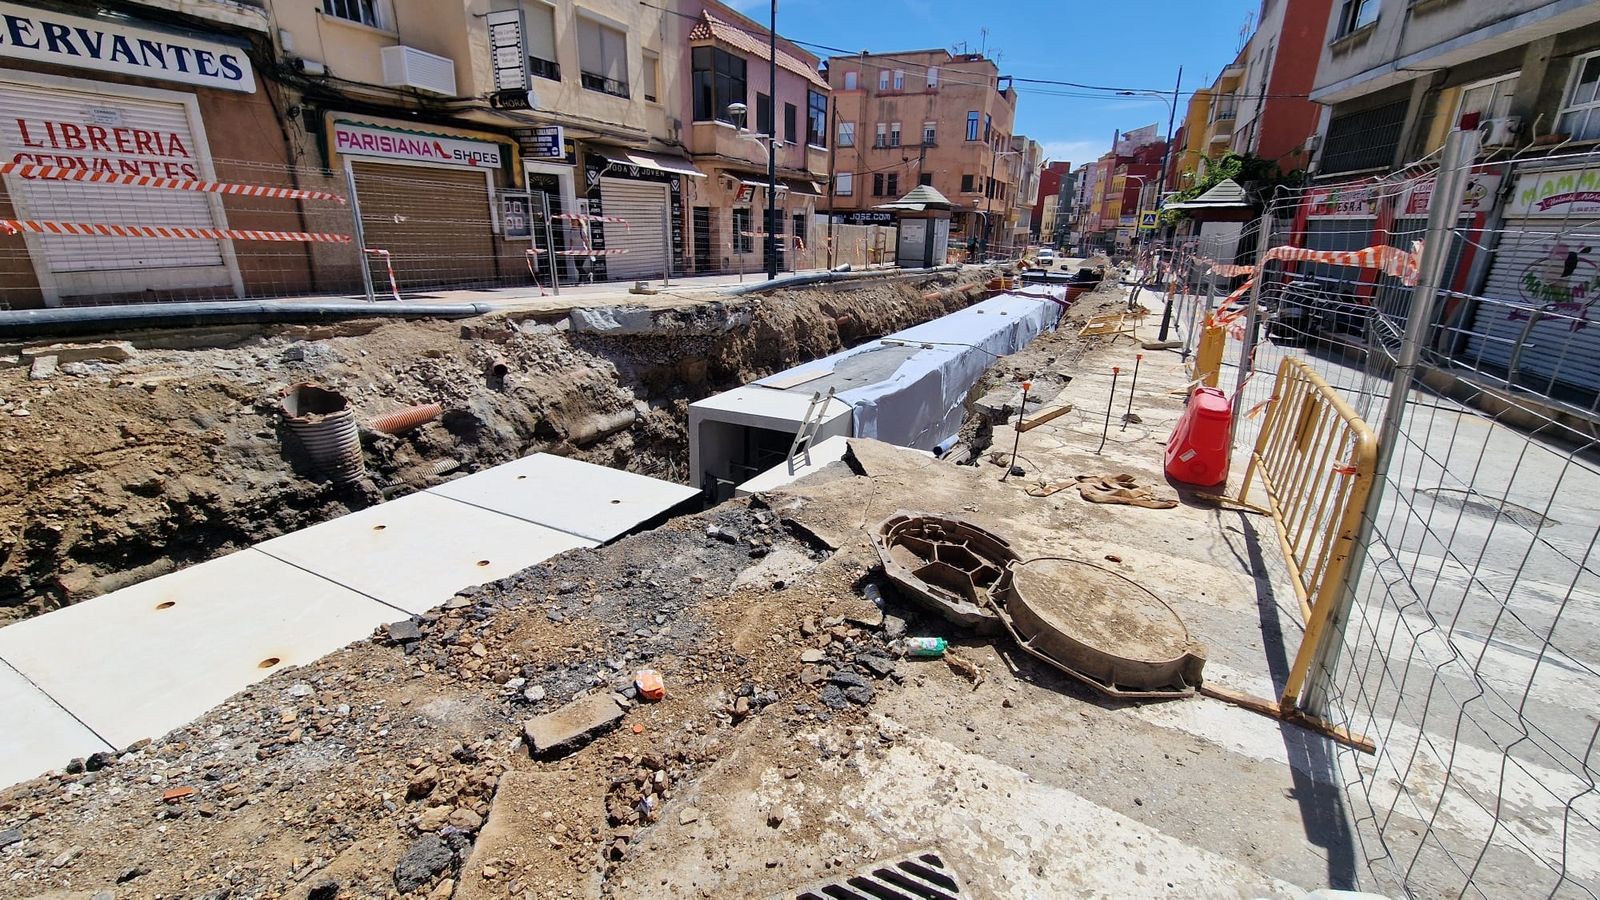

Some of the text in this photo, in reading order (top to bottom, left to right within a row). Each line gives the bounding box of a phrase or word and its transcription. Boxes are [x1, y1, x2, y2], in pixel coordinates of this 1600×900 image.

[0, 14, 243, 81] ERVANTES
[502, 99, 526, 108] HORA
[15, 118, 191, 158] LIBRERIA
[336, 131, 498, 164] PARISIANA SHOES
[1337, 202, 1362, 212] ESRA
